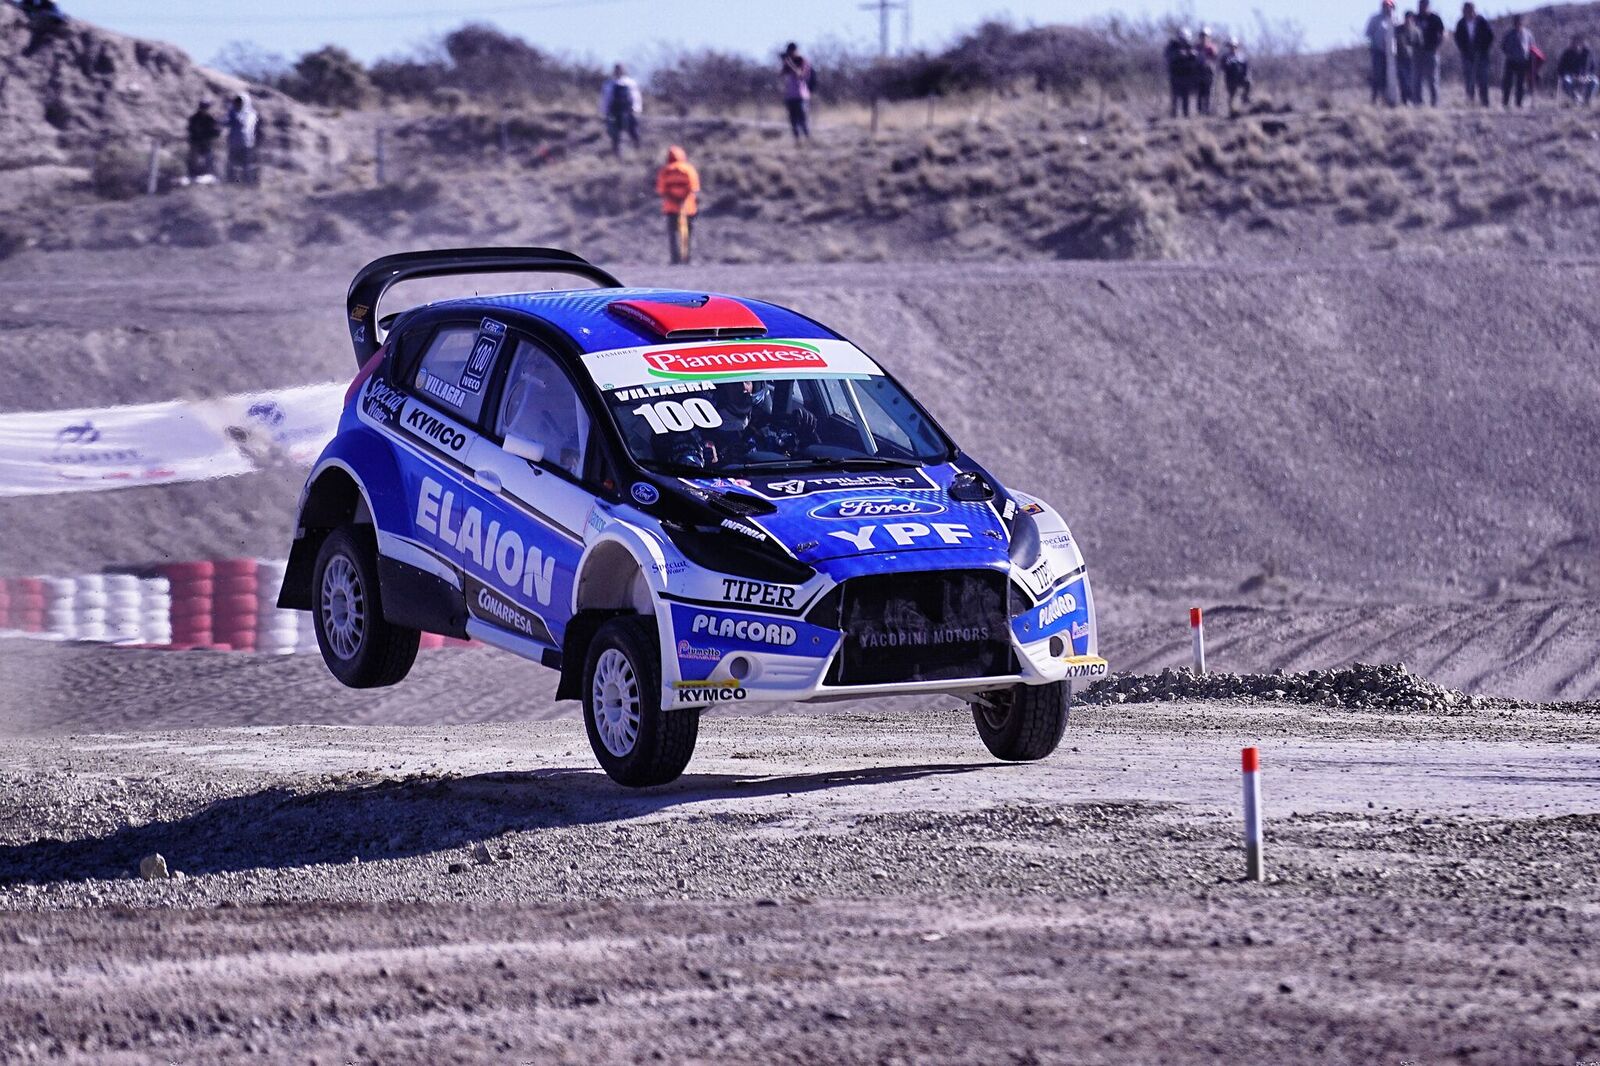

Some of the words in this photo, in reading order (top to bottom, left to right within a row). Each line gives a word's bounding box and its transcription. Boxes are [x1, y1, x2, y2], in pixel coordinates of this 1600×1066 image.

[471, 342, 493, 372] 100
[647, 349, 819, 371] Piamontesa
[424, 374, 467, 408] VILLAGRA
[461, 375, 481, 391] IVECO
[614, 380, 717, 402] VILLAGRA
[406, 407, 467, 452] KYMCO
[632, 397, 723, 435] 100
[839, 498, 922, 517] Ford
[415, 476, 556, 607] ELAION
[720, 518, 767, 542] INFINIA
[828, 522, 973, 551] YPF
[723, 578, 796, 607] TIPER
[478, 588, 533, 636] CONARPESA
[692, 614, 797, 646] PLACORD
[860, 631, 928, 648] YACOPINI
[934, 627, 990, 644] MOTORS
[1065, 663, 1106, 678] KYMCO
[679, 688, 747, 702] KYMCO
